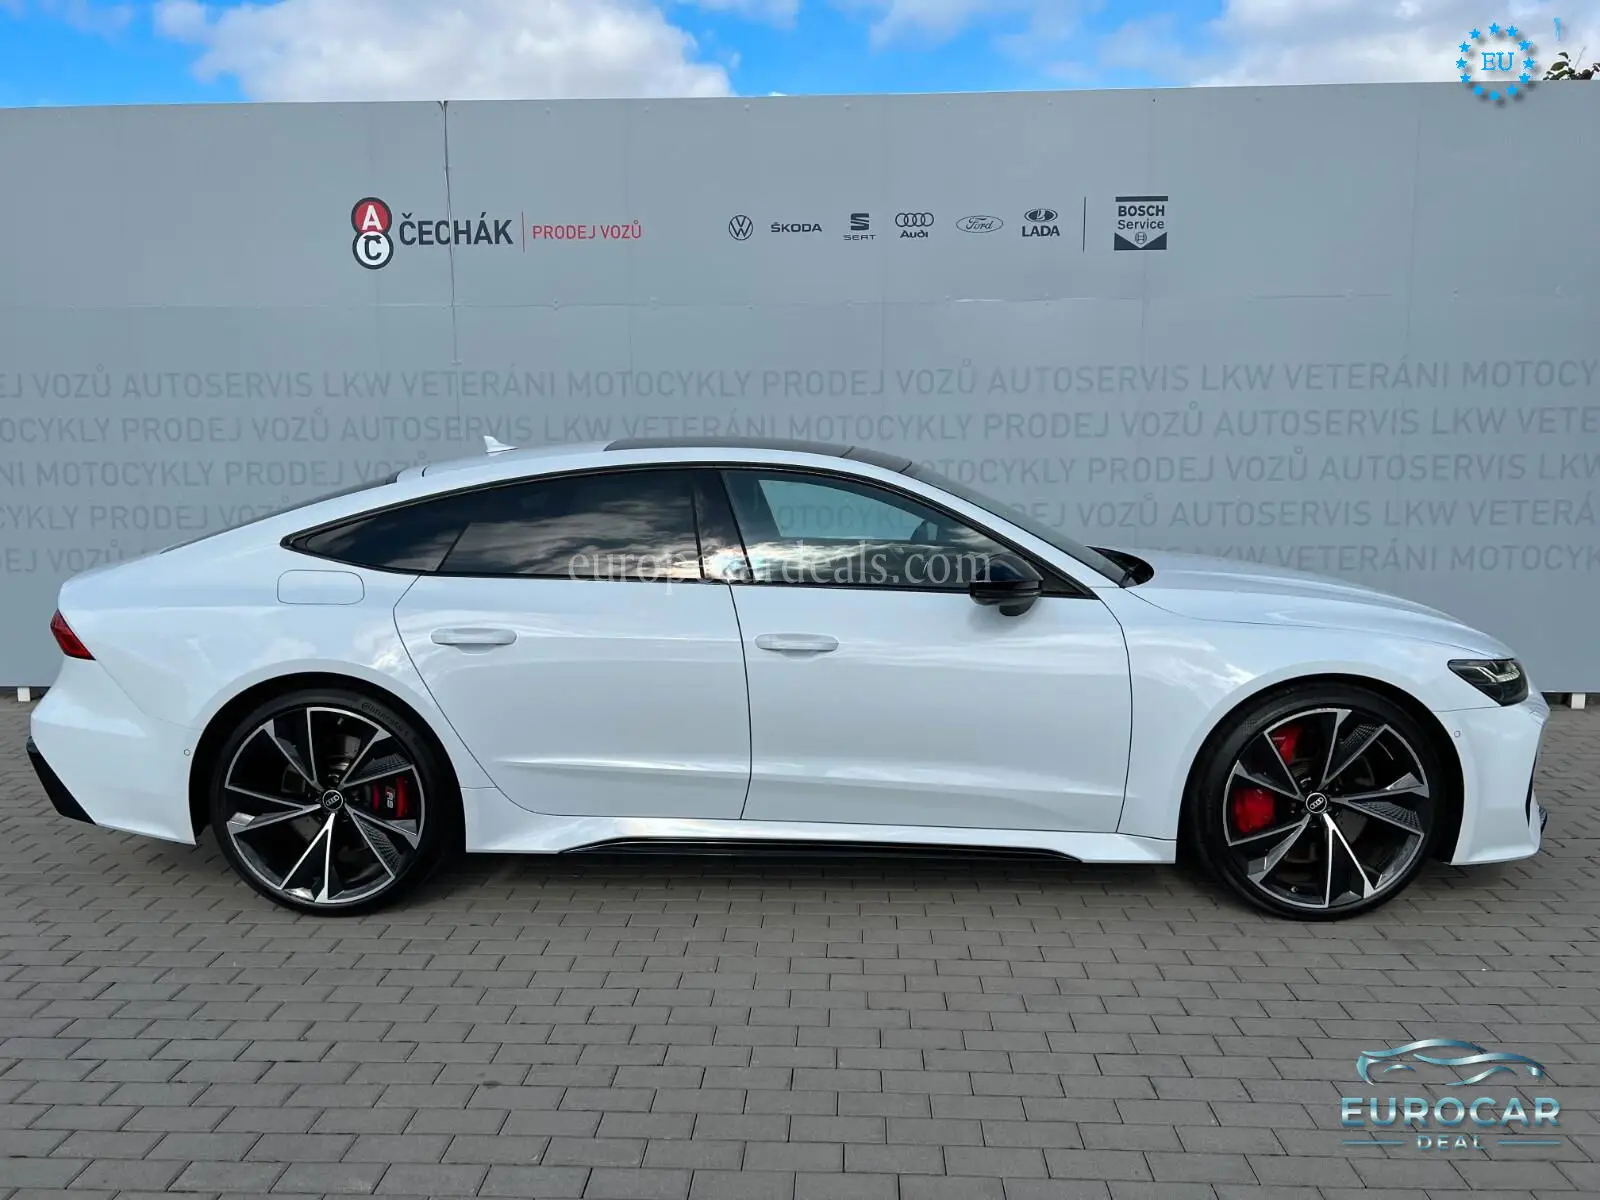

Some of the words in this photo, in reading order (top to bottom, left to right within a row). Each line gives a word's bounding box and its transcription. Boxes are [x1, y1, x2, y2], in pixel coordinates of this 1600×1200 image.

[361, 204, 382, 230] A
[965, 216, 994, 231] Ford
[1117, 205, 1165, 217] BOSCH
[399, 212, 513, 246] ČECHÁK
[532, 225, 596, 240] PRODEJ
[600, 219, 642, 240] VOZŮ
[770, 222, 823, 233] ŠKODA
[899, 230, 929, 239] Audi
[1021, 225, 1061, 238] LADA
[1117, 219, 1165, 230] Service
[33, 363, 110, 399] VOZŮ
[123, 372, 312, 399] AUTOSERVIS
[324, 371, 391, 398] LKW
[402, 364, 555, 398] VETERÁNI
[569, 370, 751, 398] MOTOCYKLY
[764, 369, 884, 397] PRODEJ
[898, 359, 976, 395] VOZŮ
[988, 365, 1189, 394] AUTOSERVIS
[1202, 363, 1275, 391] LKW
[1284, 356, 1450, 390] VETERÁNI
[1463, 360, 1599, 389] MOTOCY
[0, 417, 110, 443] OCYKLY
[122, 417, 243, 443] PRODEJ
[252, 406, 329, 443] VOZŮ
[340, 415, 533, 442] AUTOSERVIS
[545, 414, 612, 442] LKW
[622, 407, 776, 438] VETERÁNI
[788, 413, 972, 441] MOTOCYKLY
[984, 411, 1110, 440] PRODEJ
[1121, 401, 1203, 438] VOZŮ
[1214, 408, 1418, 437] AUTOSERVIS
[1432, 406, 1507, 435] LKW
[1518, 406, 1599, 434] VETE
[36, 461, 215, 488] MOTOCYKLY
[225, 461, 343, 487] PRODEJ
[1088, 456, 1214, 484] PRODEJ
[1226, 446, 1308, 482] VOZŮ
[1319, 453, 1526, 481] AUTOSERVIS
[0, 504, 78, 530] YKLY
[90, 504, 208, 530] PRODEJ
[1077, 492, 1158, 528] VOZŮ
[1169, 499, 1371, 528] AUTOSERVIS
[1385, 499, 1455, 526] LKW
[1468, 490, 1595, 527] VETERÁ
[1275, 537, 1437, 571] VETERÁNI
